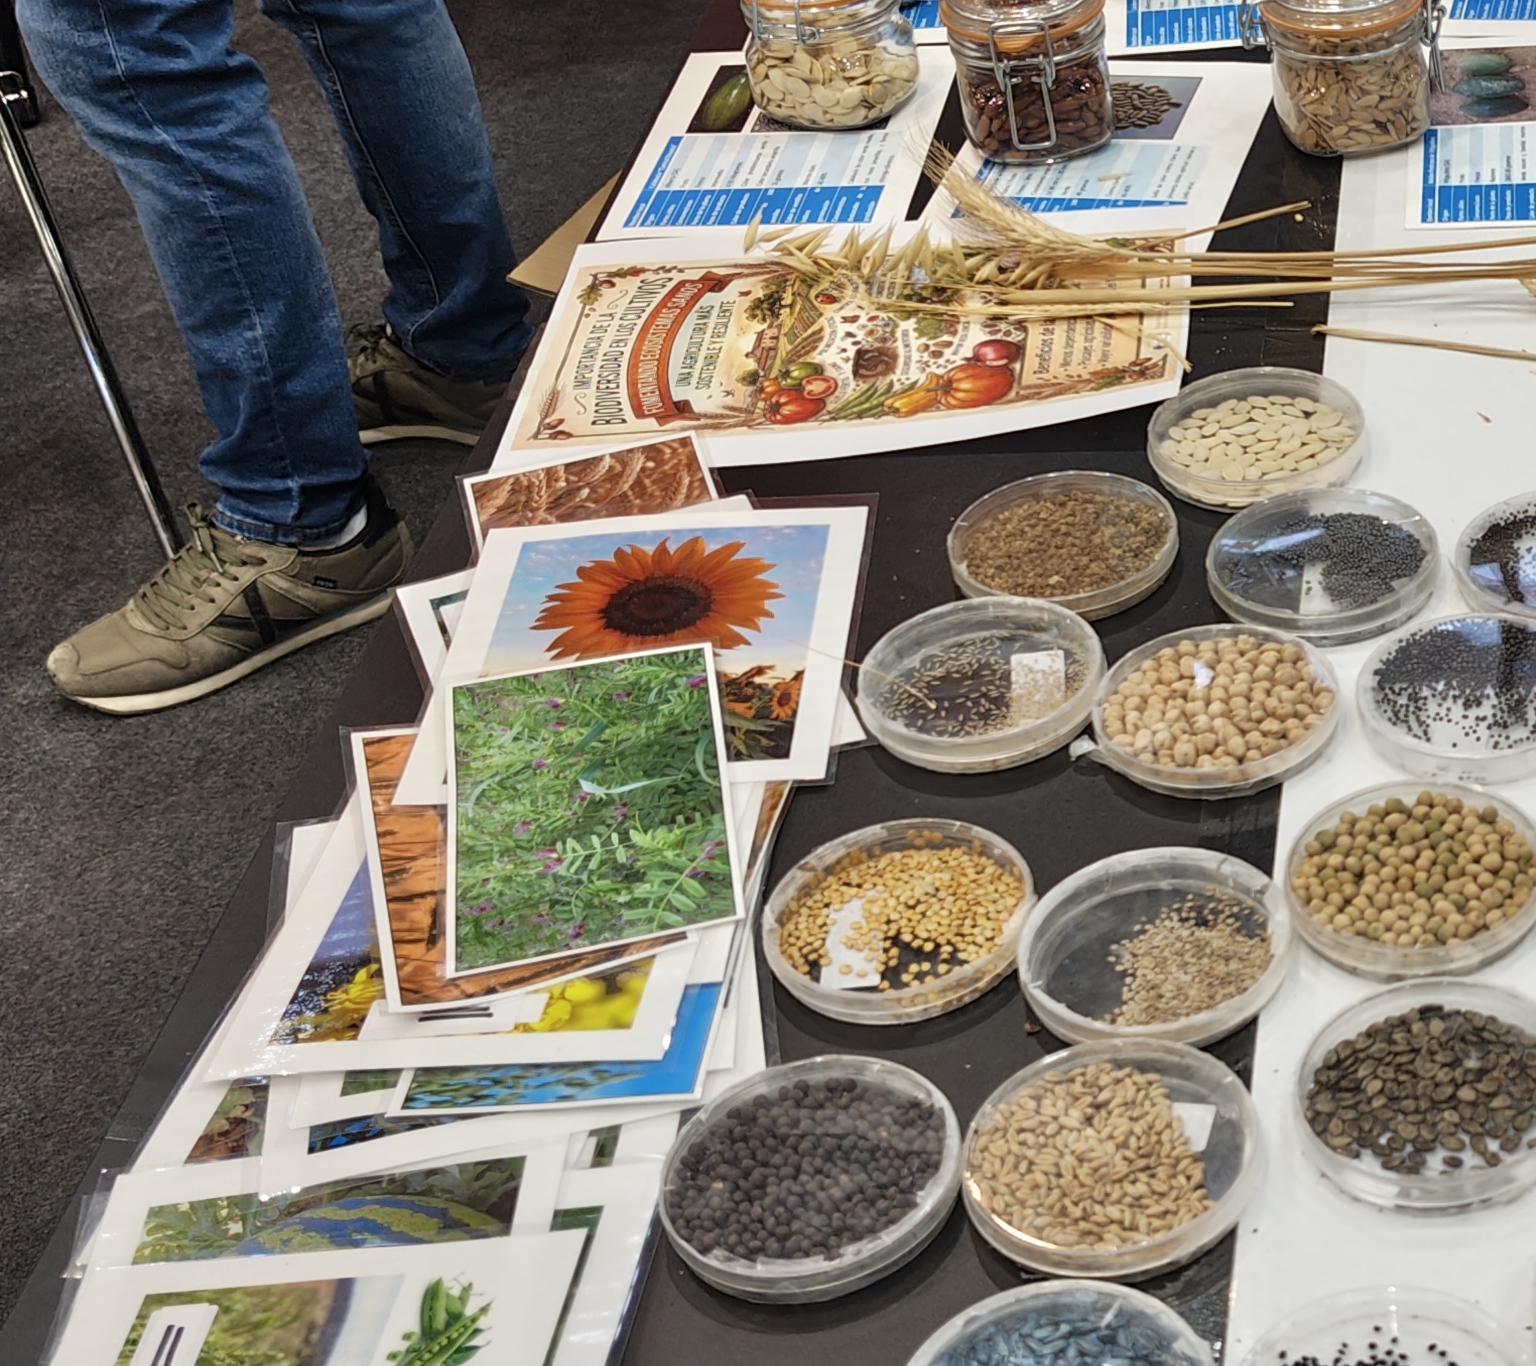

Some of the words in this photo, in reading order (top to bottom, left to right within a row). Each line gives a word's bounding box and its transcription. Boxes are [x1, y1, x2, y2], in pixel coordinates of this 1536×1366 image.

[596, 311, 617, 322] LA
[620, 277, 674, 322] CULTIVOS
[667, 282, 703, 309] SANOS
[589, 322, 611, 334] DE
[609, 338, 629, 348] EN
[614, 323, 636, 336] LOS
[639, 308, 681, 360] ECOSISTEMAS
[682, 322, 708, 370] AGRICULTURA
[695, 346, 722, 390] SOSTENIBLE
[712, 300, 737, 339] RESILIENTE
[572, 335, 603, 390] IMPORTANCIA
[675, 371, 693, 388] UNA
[591, 350, 628, 426] BIODIVERSIDAD
[637, 360, 665, 415] FOMENTANDO
